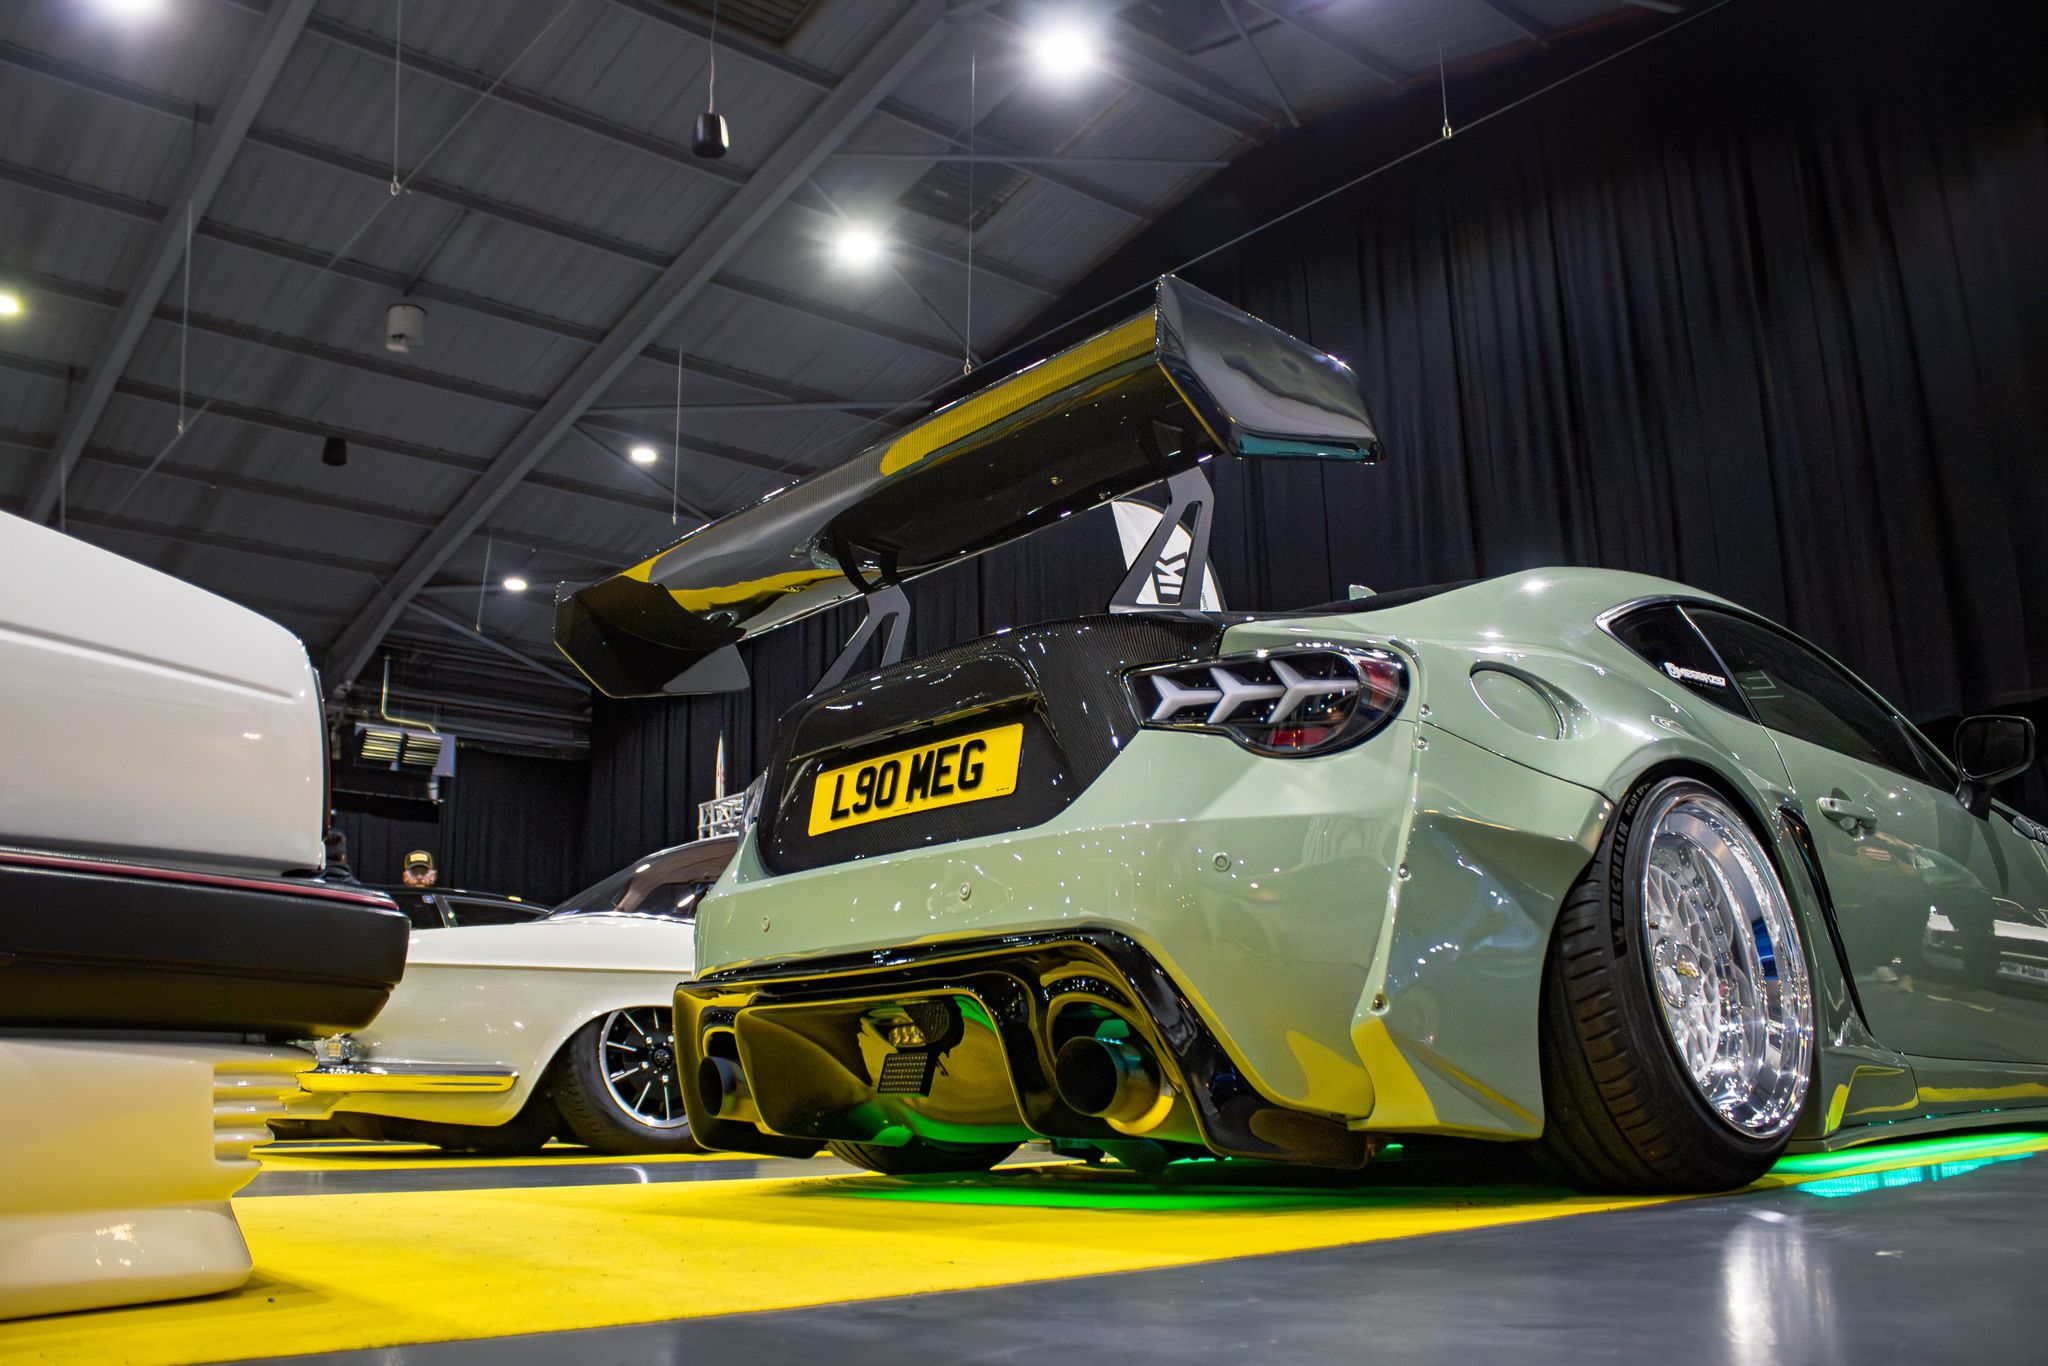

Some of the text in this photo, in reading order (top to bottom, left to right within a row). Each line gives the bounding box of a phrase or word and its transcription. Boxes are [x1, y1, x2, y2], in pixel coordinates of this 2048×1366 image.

[830, 739, 987, 820] L90 MEG
[1611, 822, 1629, 917] MICHELIN
[1625, 793, 1640, 816] PILOT
